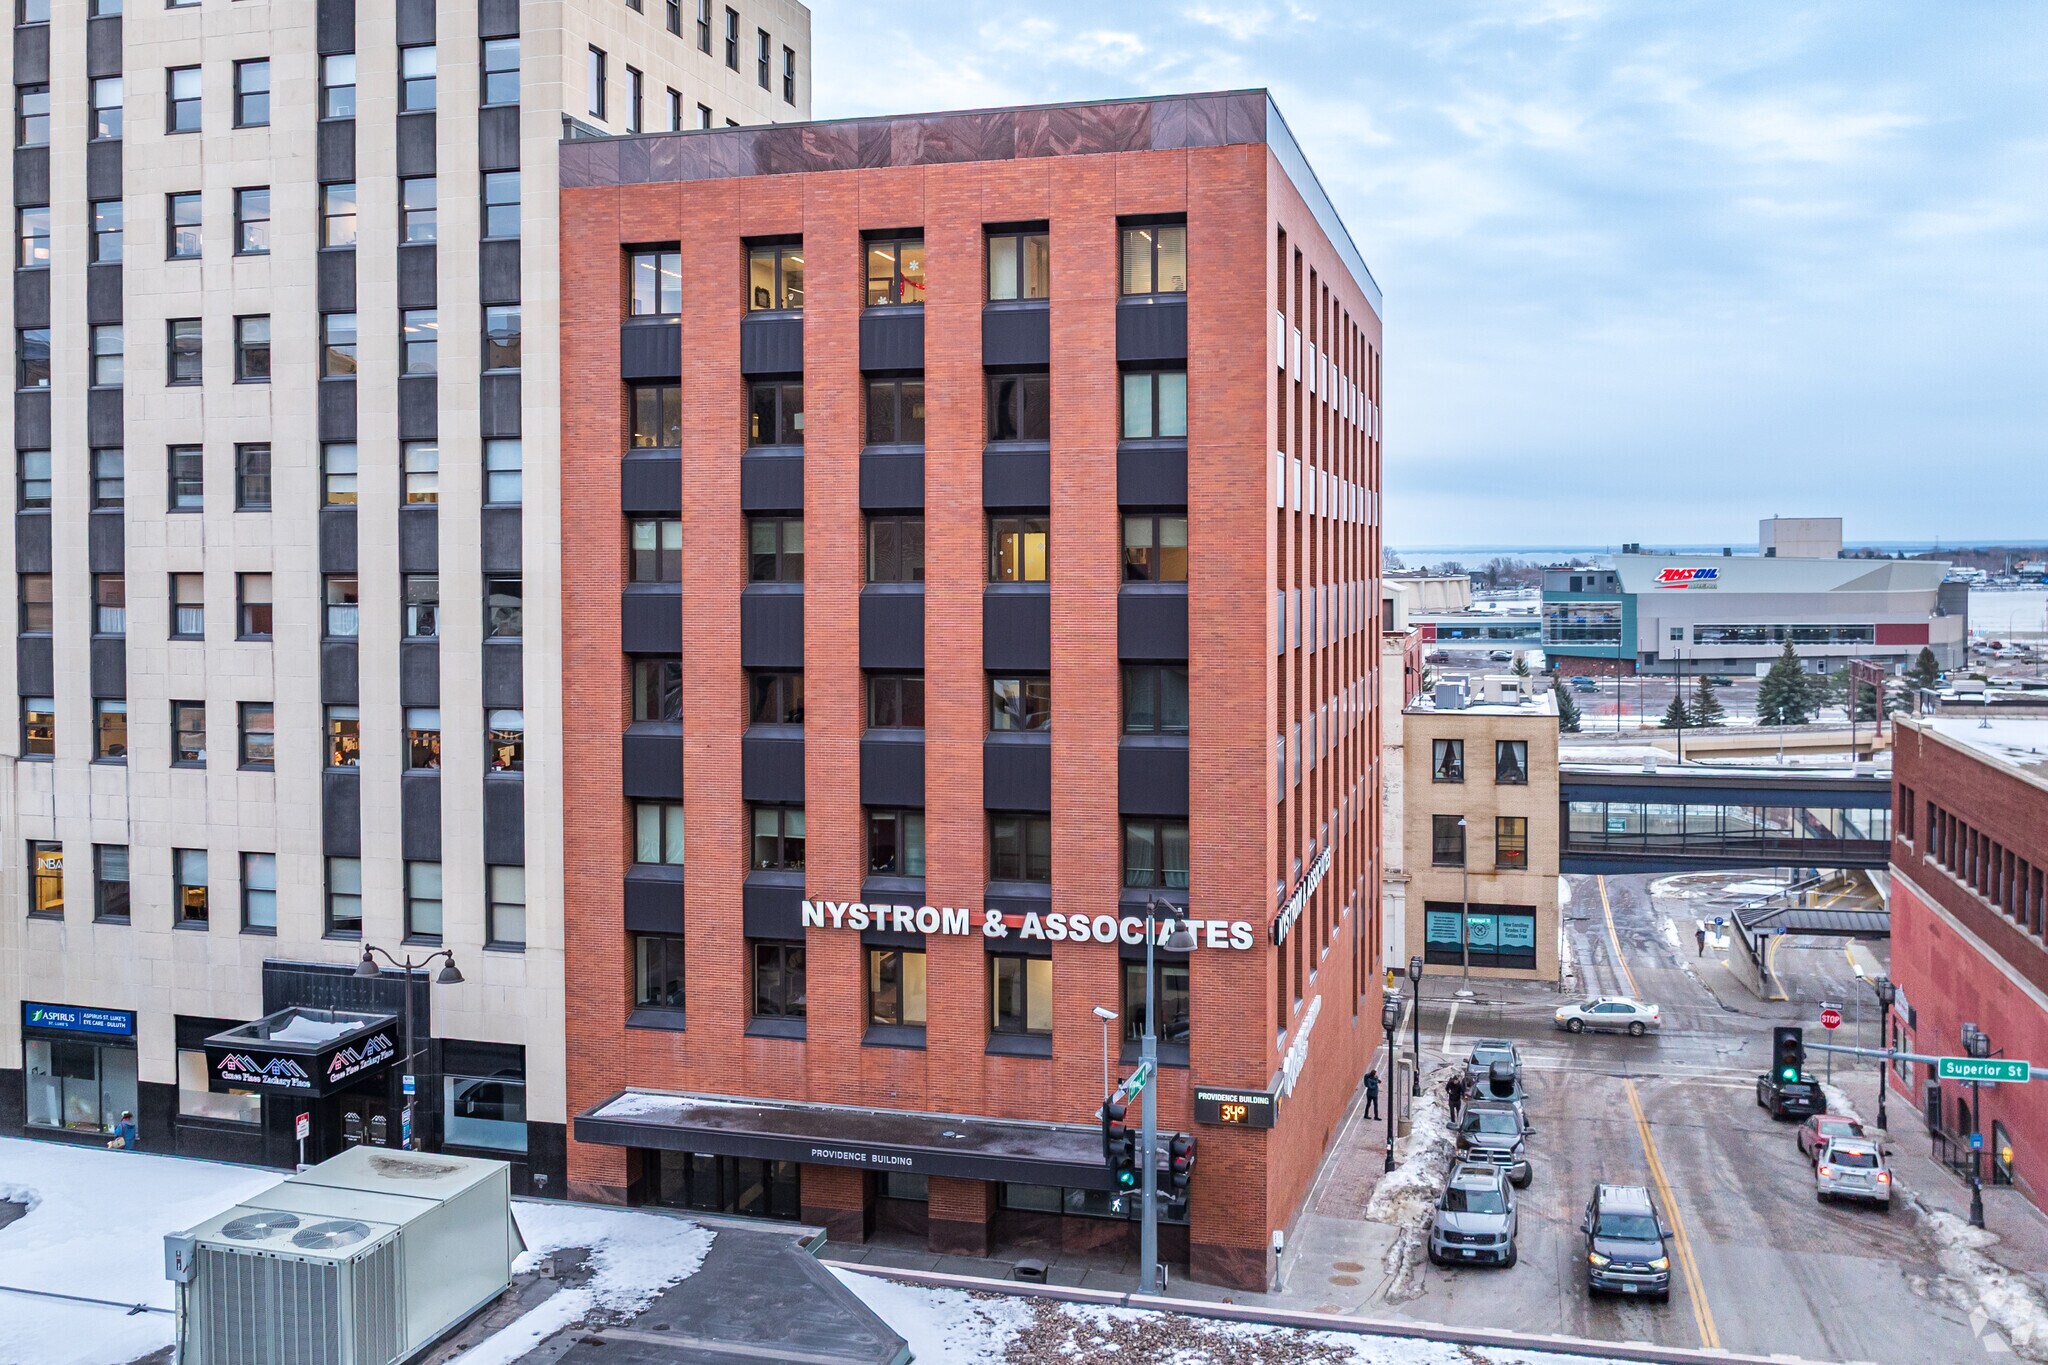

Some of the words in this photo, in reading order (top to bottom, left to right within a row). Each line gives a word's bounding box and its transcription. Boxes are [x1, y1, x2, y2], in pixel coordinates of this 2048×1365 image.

[1657, 568, 1719, 582] AMSOIL
[37, 857, 63, 871] JNBA
[801, 900, 970, 936] NYSTROM
[982, 909, 1009, 938] &
[43, 1012, 75, 1022] ASPIRUS
[1821, 1014, 1840, 1024] STOP
[1946, 1062, 2002, 1076] Superior
[2008, 1065, 2022, 1077] St
[221, 1071, 242, 1081] Grace
[242, 1073, 261, 1082] Place
[262, 1075, 291, 1087] Zachary
[291, 1077, 311, 1088] Place
[1198, 1092, 1238, 1103] PROVIDENCE
[1239, 1095, 1269, 1105] BUILDING
[811, 1148, 867, 1162] PROVIDENCE
[871, 1154, 913, 1166] BUILDING
